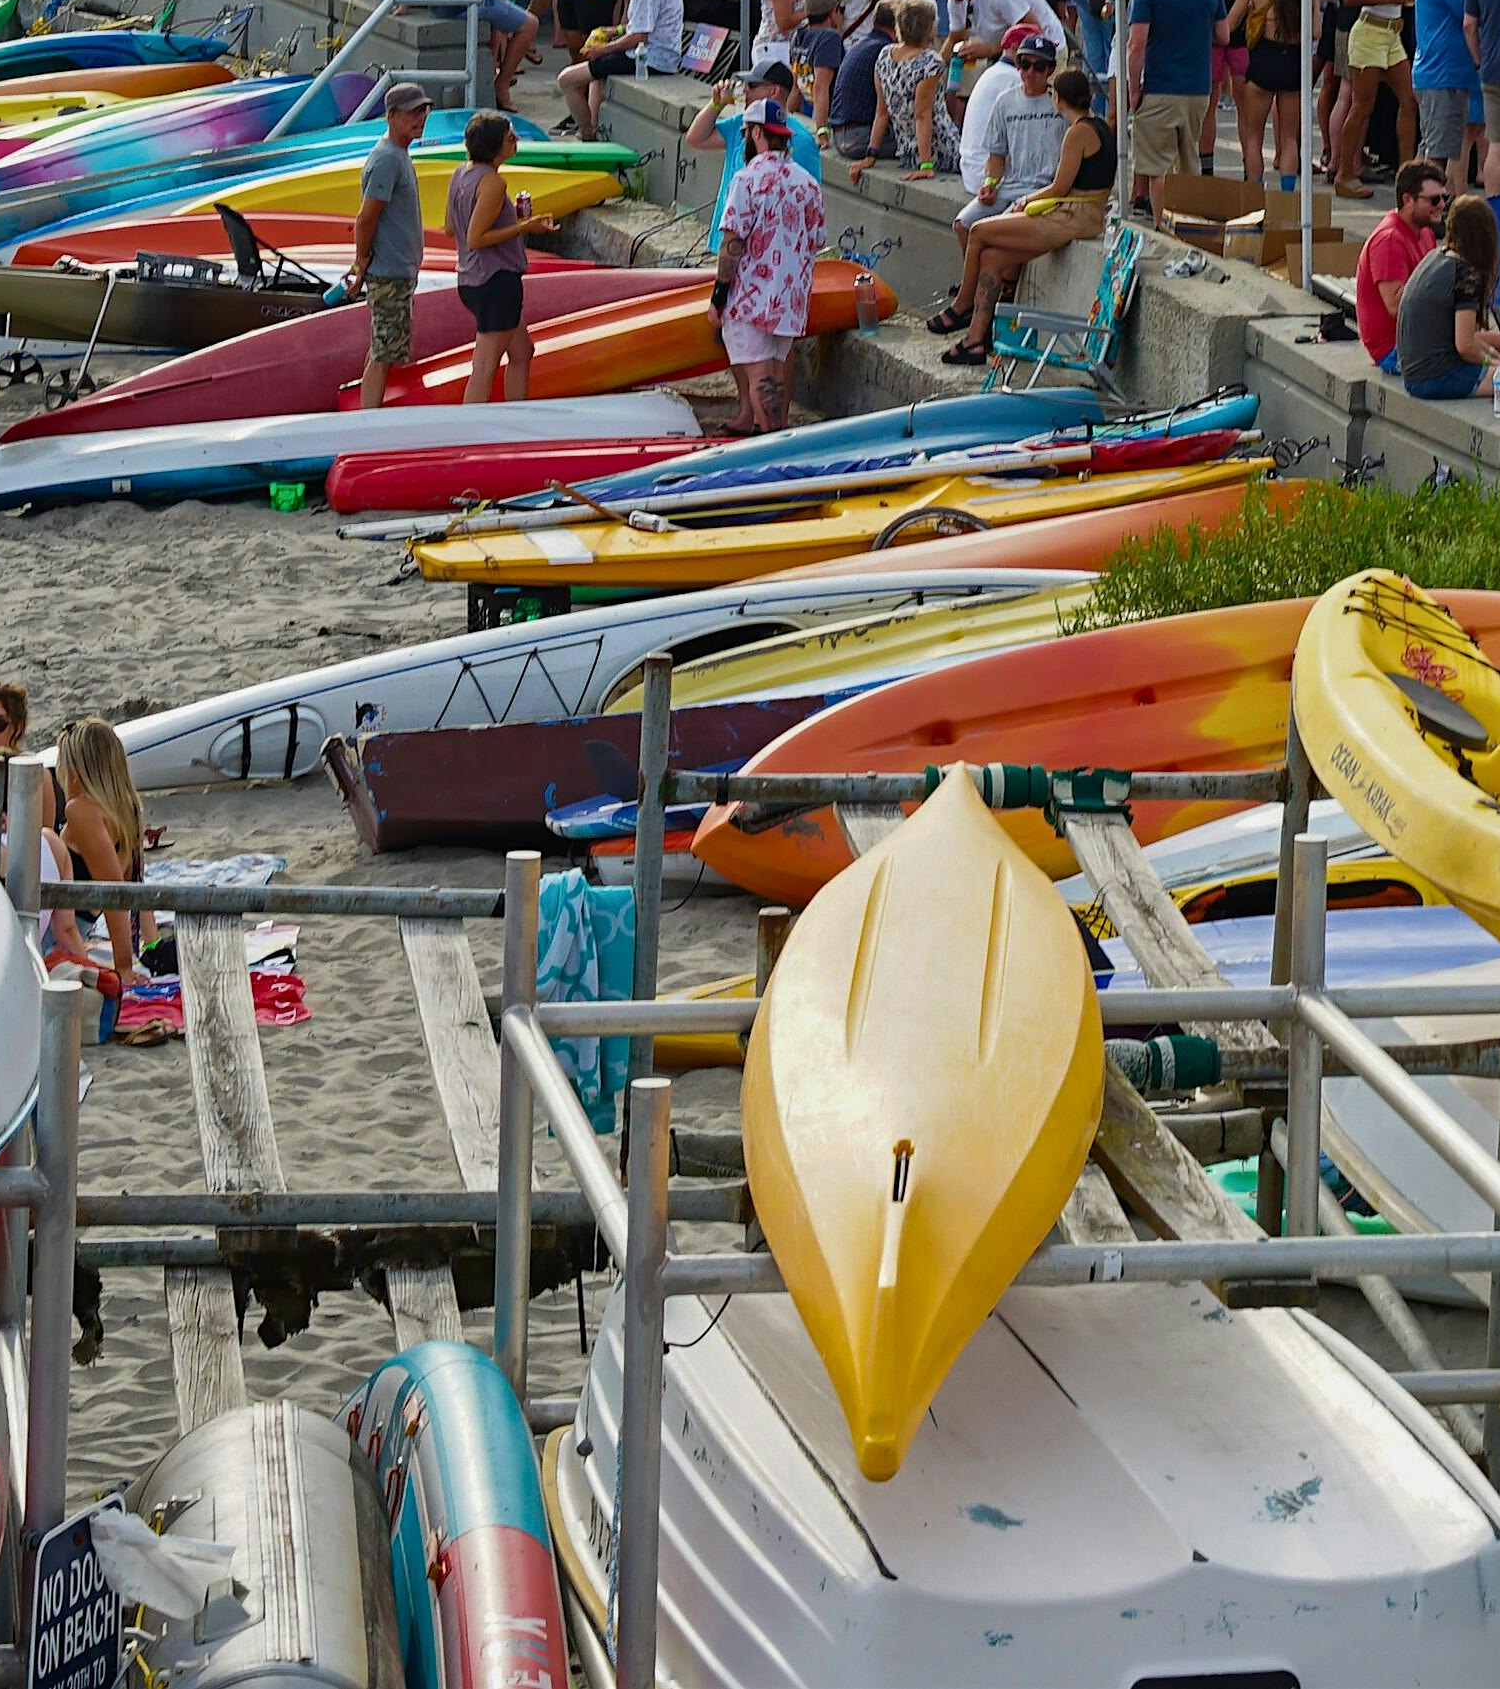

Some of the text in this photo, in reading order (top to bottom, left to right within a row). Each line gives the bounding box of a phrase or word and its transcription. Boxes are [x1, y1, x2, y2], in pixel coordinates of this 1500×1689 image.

[1331, 742, 1394, 824] OCEAN KAYAK
[37, 1590, 117, 1680] ON BEACH
[40, 1568, 64, 1626] NO
